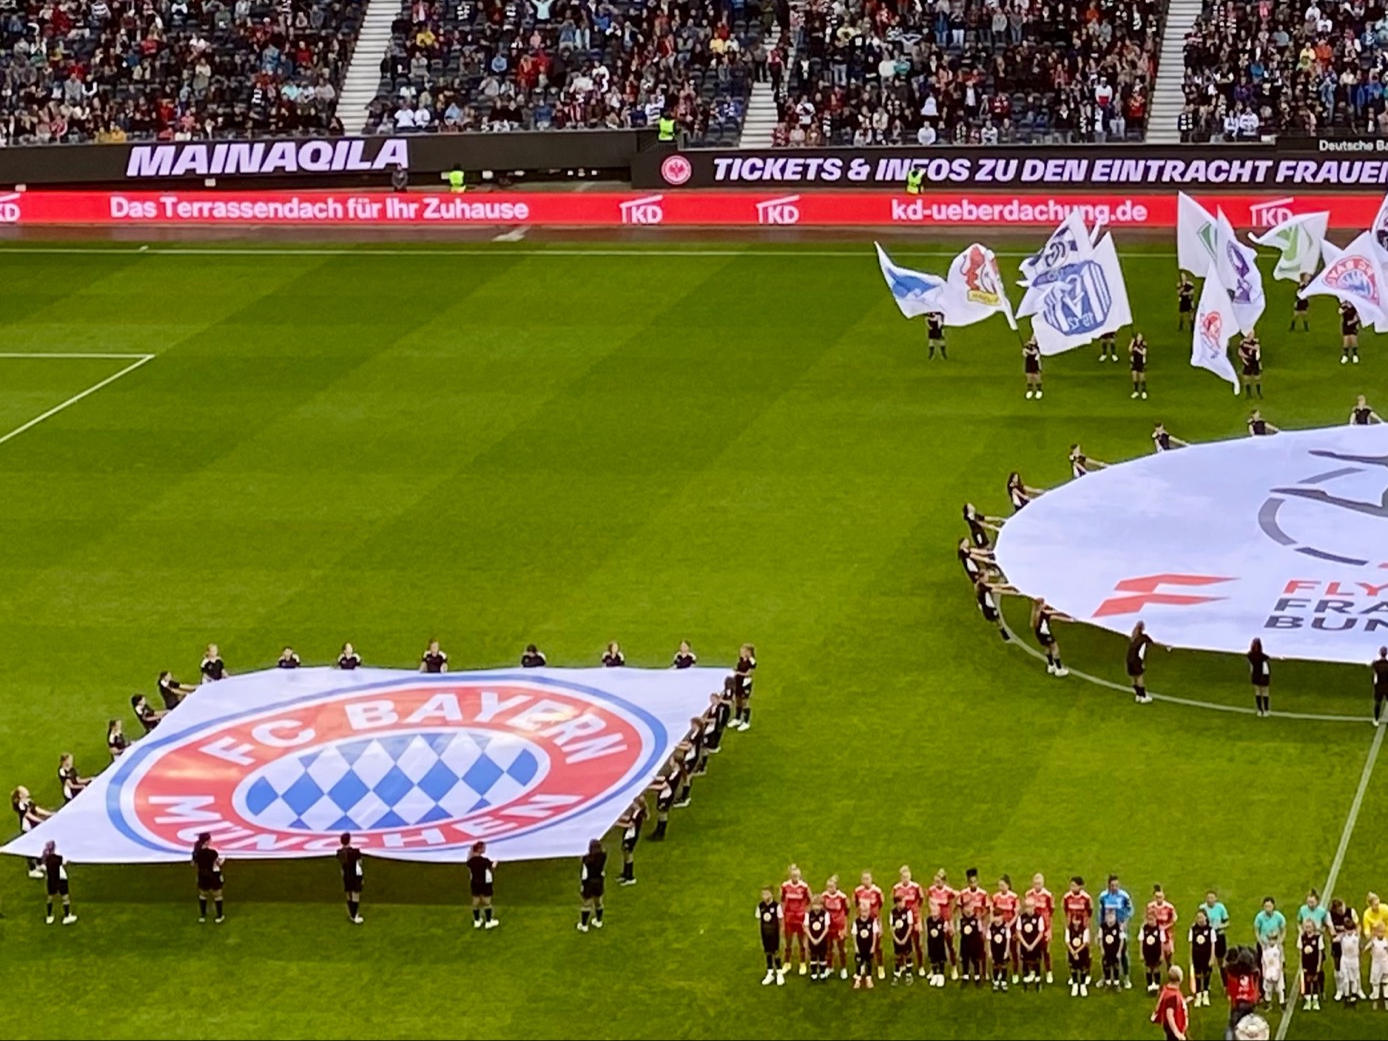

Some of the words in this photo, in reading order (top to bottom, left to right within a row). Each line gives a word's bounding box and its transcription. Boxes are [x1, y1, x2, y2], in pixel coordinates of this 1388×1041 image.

[127, 136, 408, 177] MAINAQILA
[1320, 140, 1373, 151] Deutsche
[714, 157, 843, 182] TICKETS
[848, 158, 872, 182] &
[976, 157, 1016, 183] ZU
[1021, 158, 1088, 183] DEN
[1092, 158, 1272, 184] EINTRACHT
[111, 197, 161, 217] Das
[163, 197, 342, 218] Terrassendach
[347, 198, 381, 218] für
[386, 198, 418, 218] Ihr
[423, 198, 528, 219] Zuhause
[199, 719, 317, 766] FC
[345, 691, 628, 765] BAYERN
[148, 794, 583, 851] MÜNCHEN
